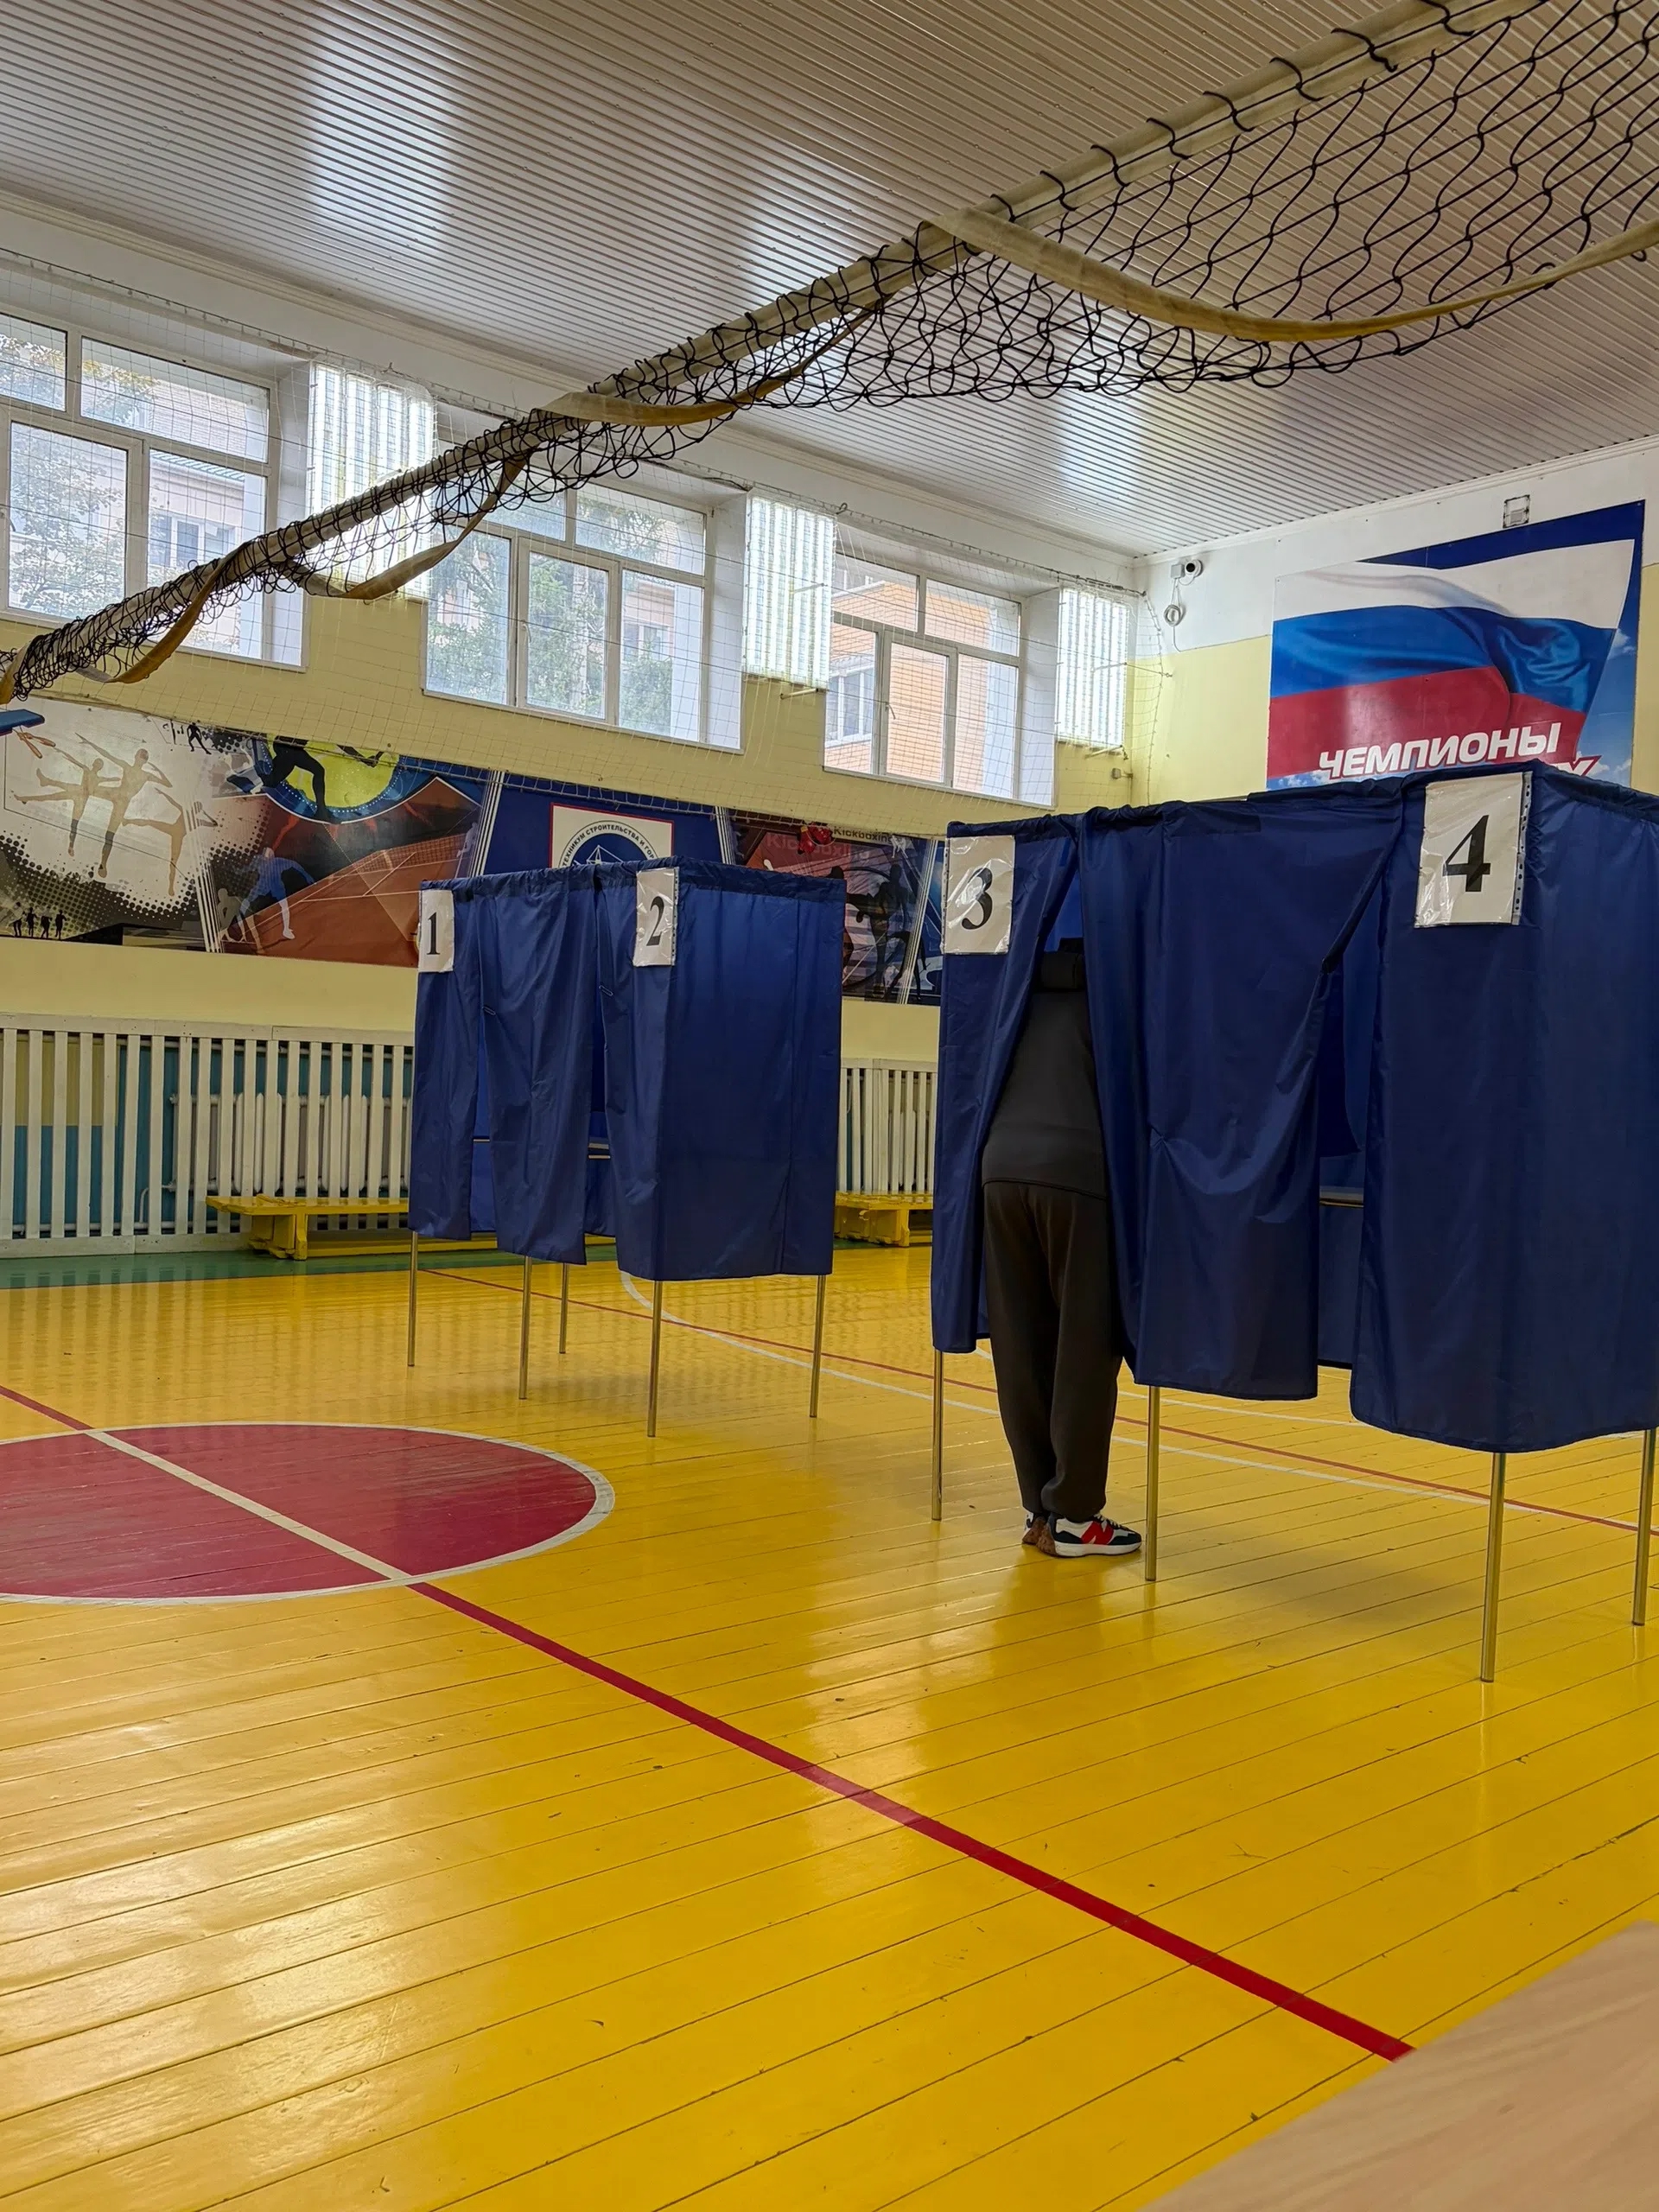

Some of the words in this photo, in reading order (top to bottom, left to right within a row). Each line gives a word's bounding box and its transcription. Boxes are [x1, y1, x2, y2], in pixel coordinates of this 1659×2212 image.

[1319, 722, 1561, 779] ЧЕМПИОНЫ
[562, 833, 586, 867] ТЕХНИКУМ
[586, 823, 639, 842] СТРОИТЕЛЬСТВА
[1441, 814, 1492, 893] 4
[646, 896, 664, 946] 2
[962, 868, 993, 930] 3
[426, 912, 441, 956] 1
